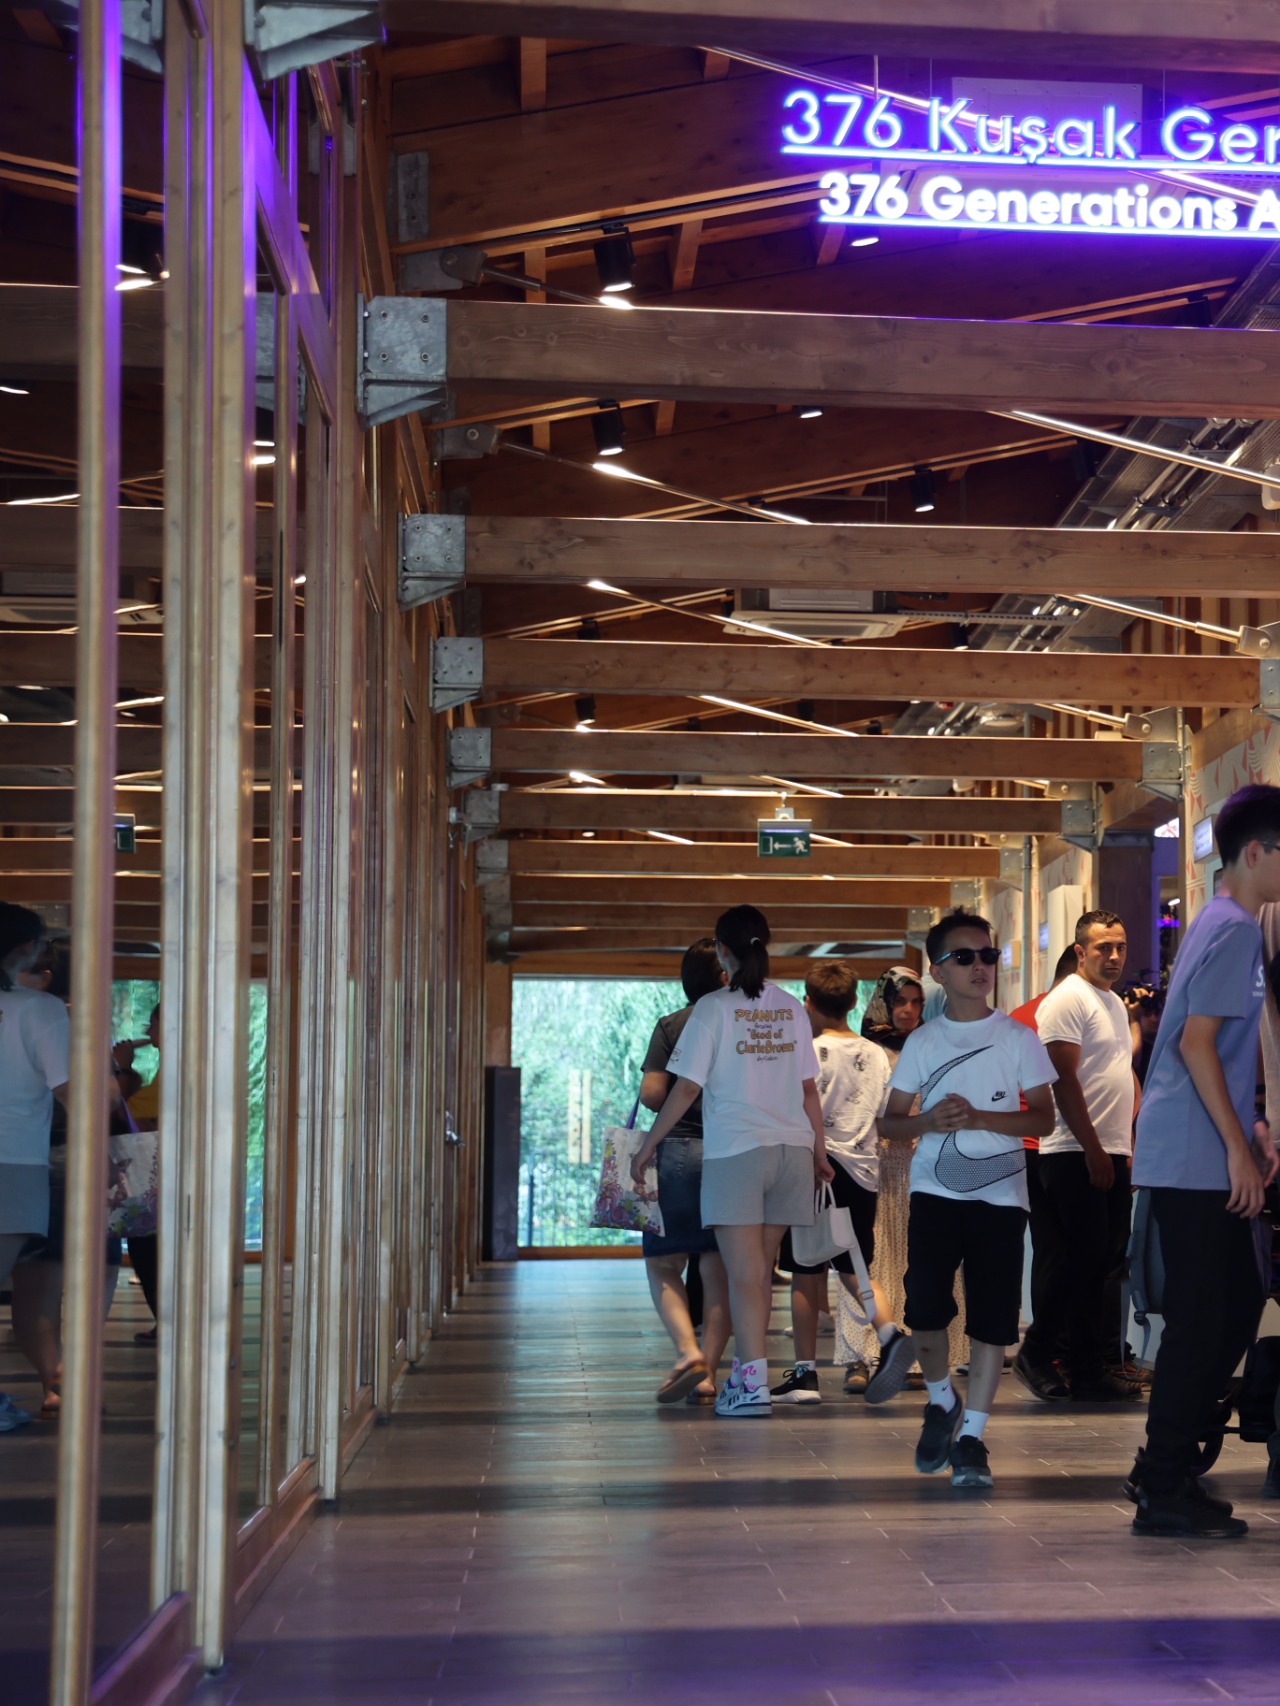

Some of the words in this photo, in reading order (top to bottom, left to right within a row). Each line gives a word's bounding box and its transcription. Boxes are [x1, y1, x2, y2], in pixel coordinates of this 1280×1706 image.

[782, 87, 903, 149] 376
[928, 96, 1137, 164] Kuşak
[818, 171, 909, 219] 376
[920, 174, 1238, 231] Generations
[734, 1008, 794, 1022] PEANUTS
